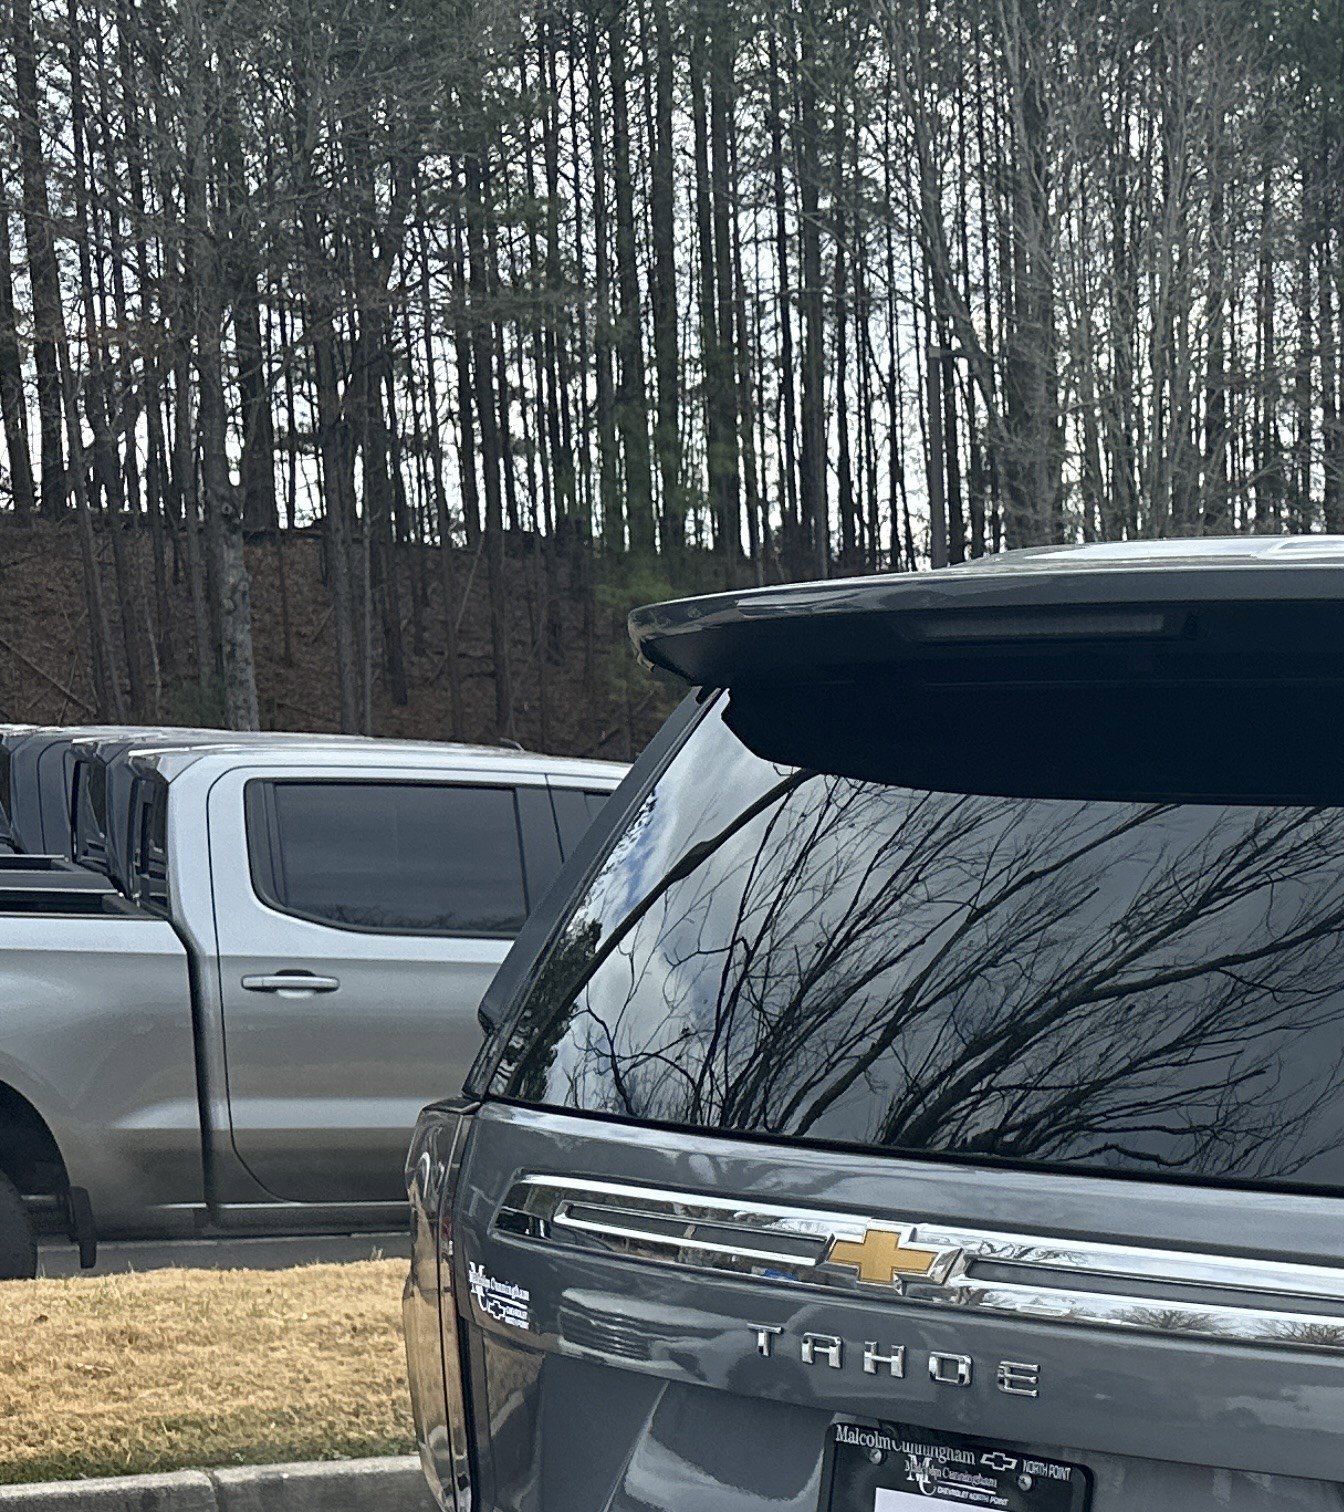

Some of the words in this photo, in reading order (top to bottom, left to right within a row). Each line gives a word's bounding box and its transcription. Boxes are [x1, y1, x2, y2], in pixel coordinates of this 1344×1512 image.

[747, 1322, 1041, 1398] TAHOE
[835, 1424, 892, 1451] Malcolm
[1022, 1459, 1049, 1478] NORTH
[1049, 1463, 1072, 1482] POINT
